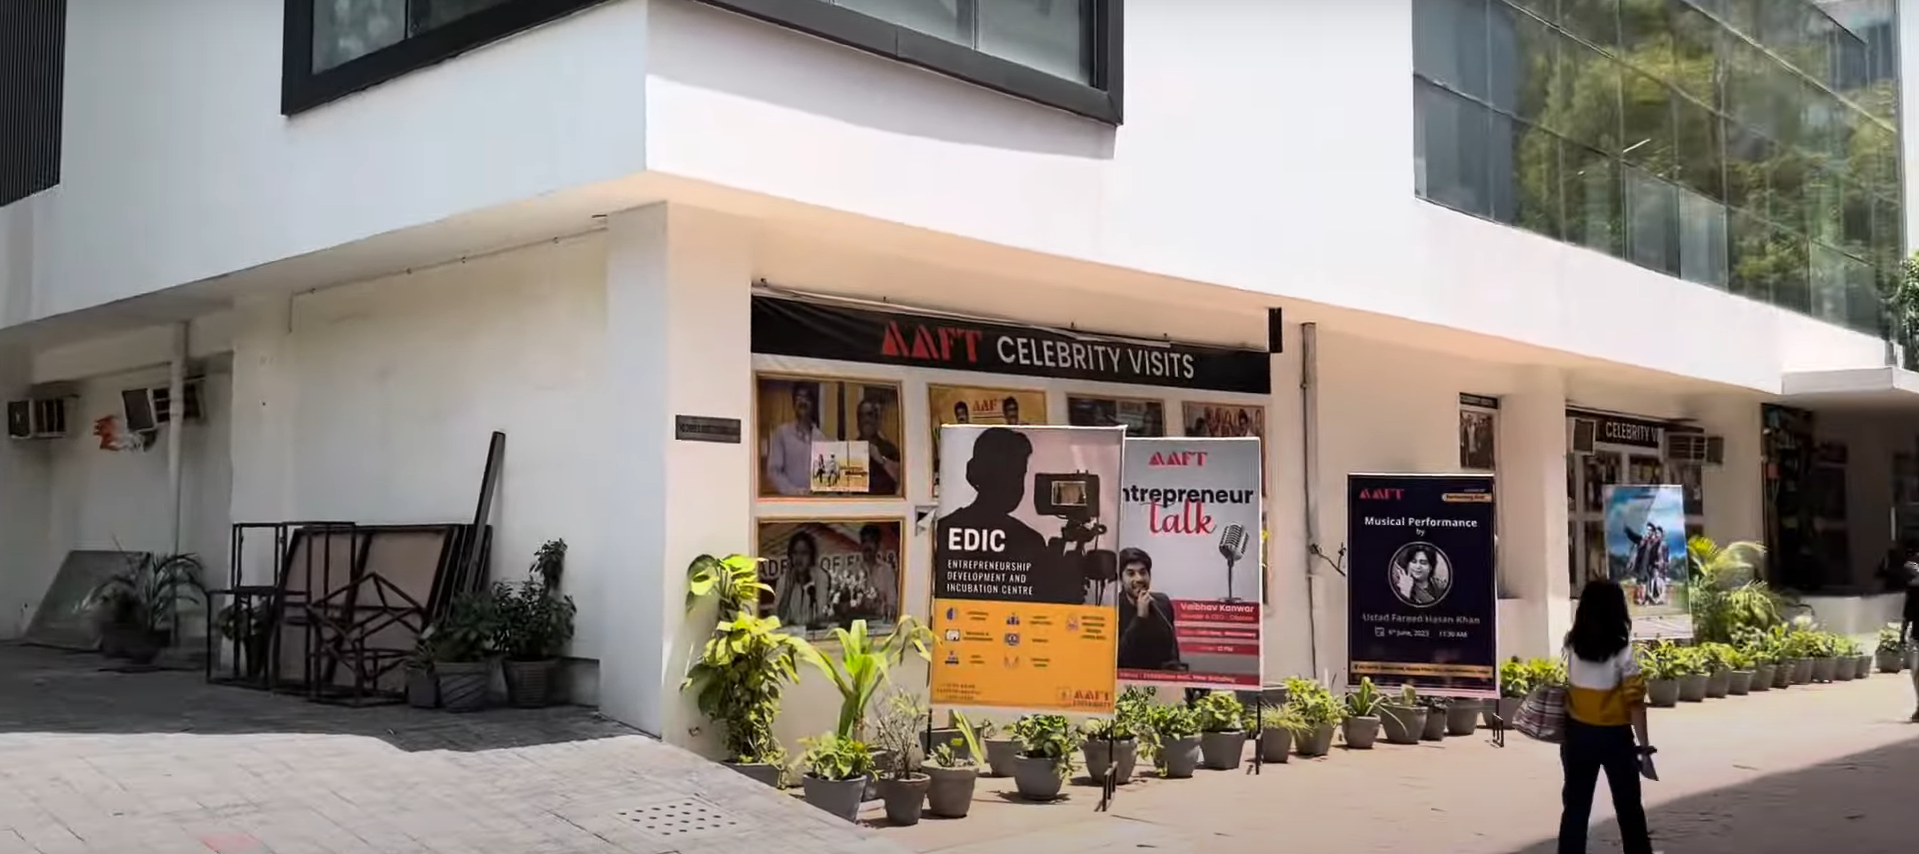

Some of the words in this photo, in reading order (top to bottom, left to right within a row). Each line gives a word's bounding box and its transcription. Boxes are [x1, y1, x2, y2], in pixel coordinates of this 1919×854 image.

[881, 320, 982, 363] AAFT
[997, 336, 1120, 373] CELEBRITY
[1128, 349, 1194, 379] VISITS
[1605, 422, 1650, 442] CELEBRITY
[1148, 451, 1208, 466] AAFT
[1122, 485, 1254, 508] ntrepreneur
[1360, 488, 1405, 500] AAFT
[1364, 517, 1405, 526] Musical
[1408, 517, 1478, 528] Performance
[1416, 528, 1425, 536] by
[948, 527, 1006, 552] EDIC
[947, 559, 1032, 571] ENTREPRENEURSHIP
[947, 572, 1006, 582] DEVELOPMENT
[1008, 573, 1027, 583] AND
[946, 583, 999, 593] INCUBATION
[1001, 585, 1034, 596] CENTRE
[1219, 603, 1255, 613] Kanwar
[1362, 613, 1390, 621] Ustad
[1455, 616, 1480, 624] Khan
